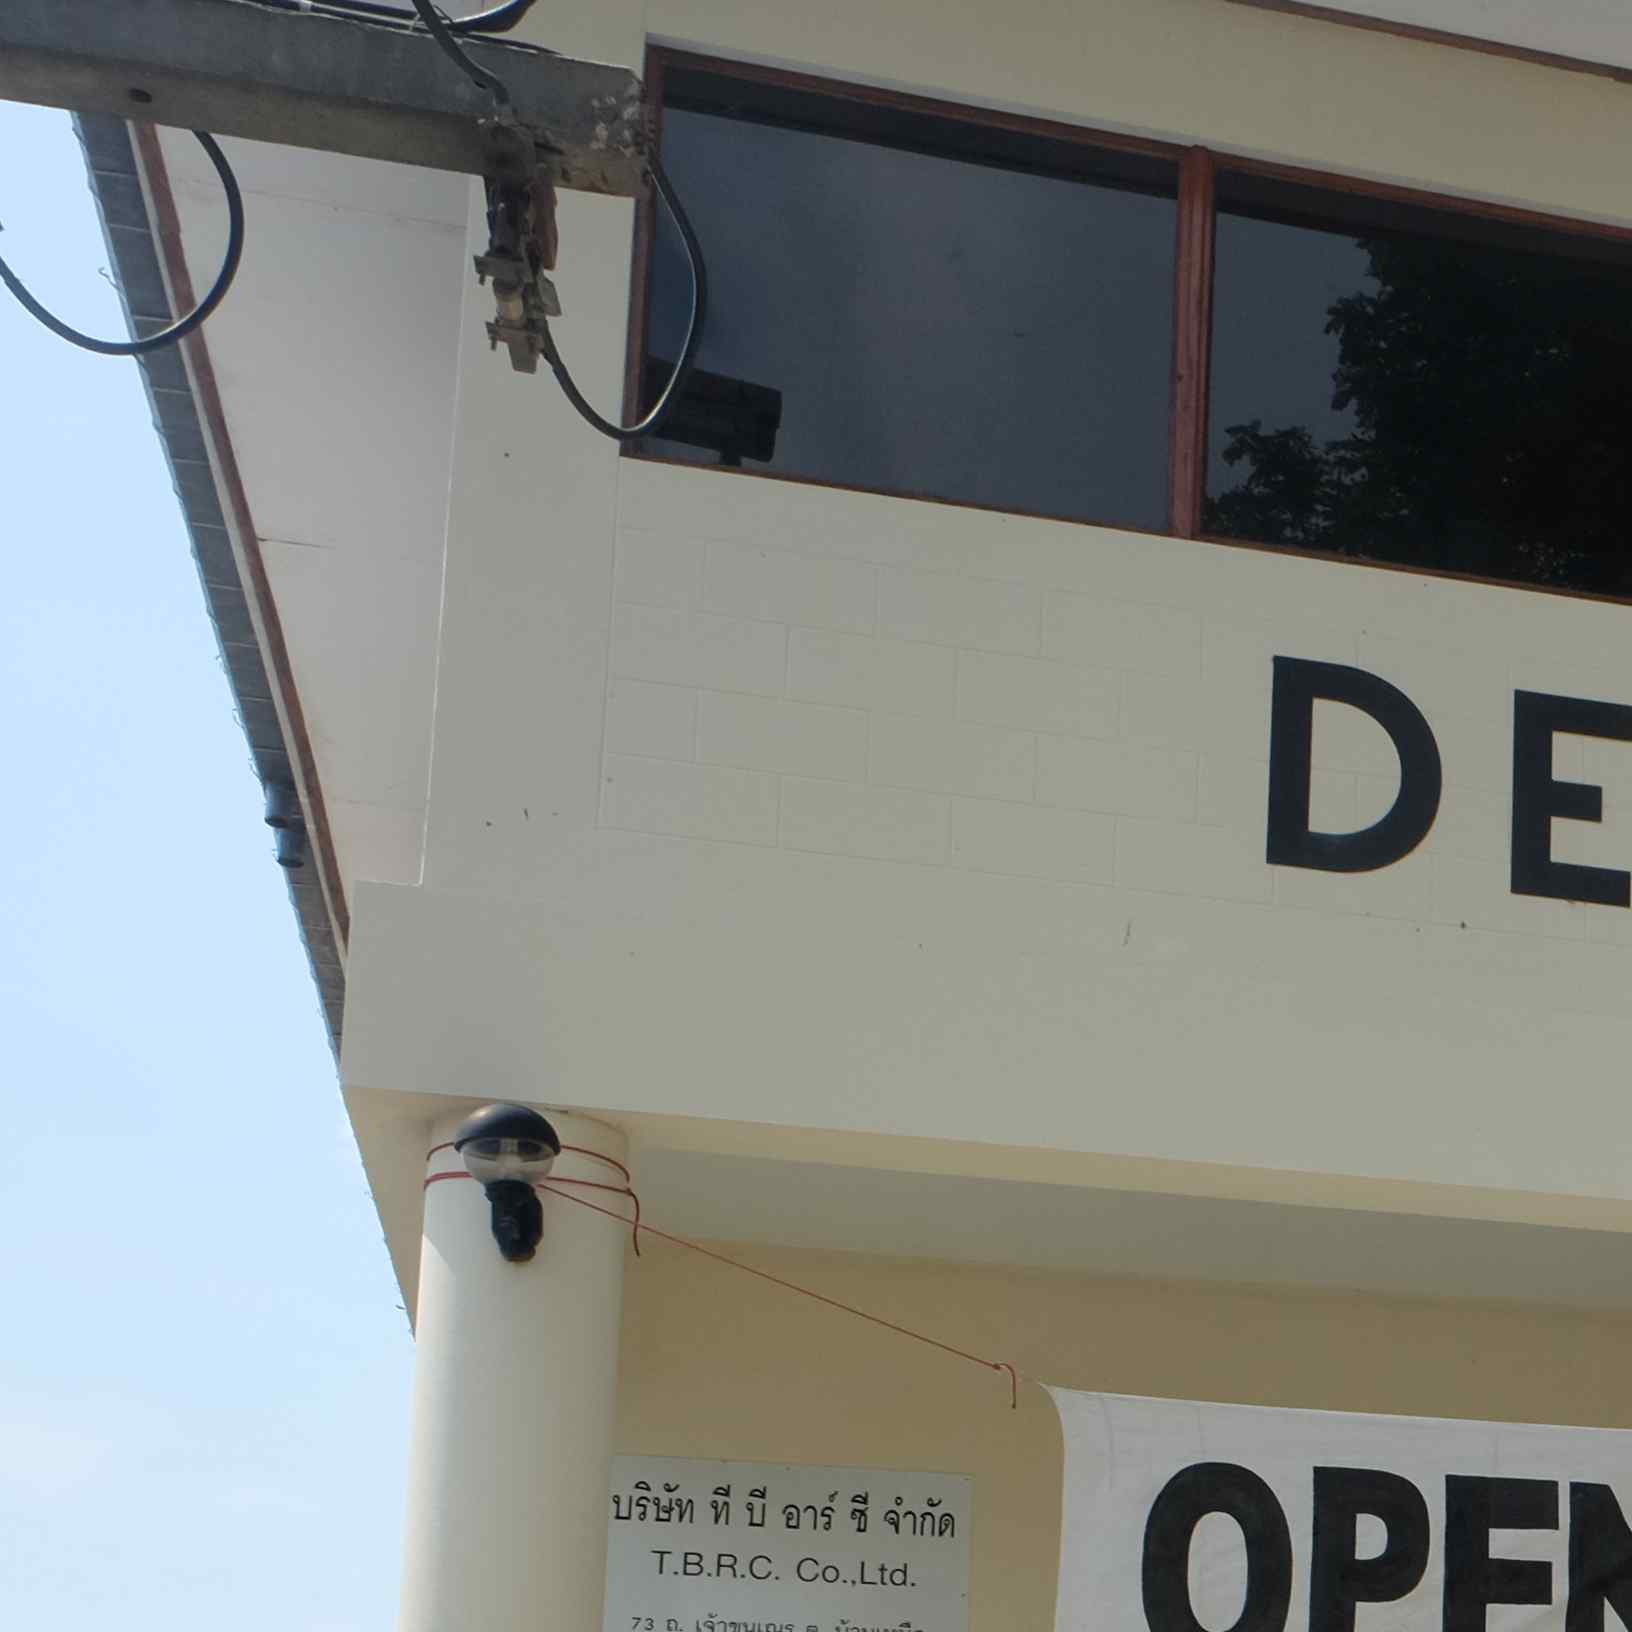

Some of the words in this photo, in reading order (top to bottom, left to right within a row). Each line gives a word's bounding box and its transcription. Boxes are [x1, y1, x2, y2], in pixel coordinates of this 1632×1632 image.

[613, 1481, 694, 1524] บริษัท
[712, 1485, 731, 1526] ที
[748, 1486, 767, 1527] บี
[782, 1490, 838, 1532] อาร์
[884, 1497, 955, 1538] จำกัด
[651, 1550, 780, 1581] T.B.R.C.
[797, 1557, 916, 1587] Co.,Ltd.
[631, 1617, 655, 1632] 73
